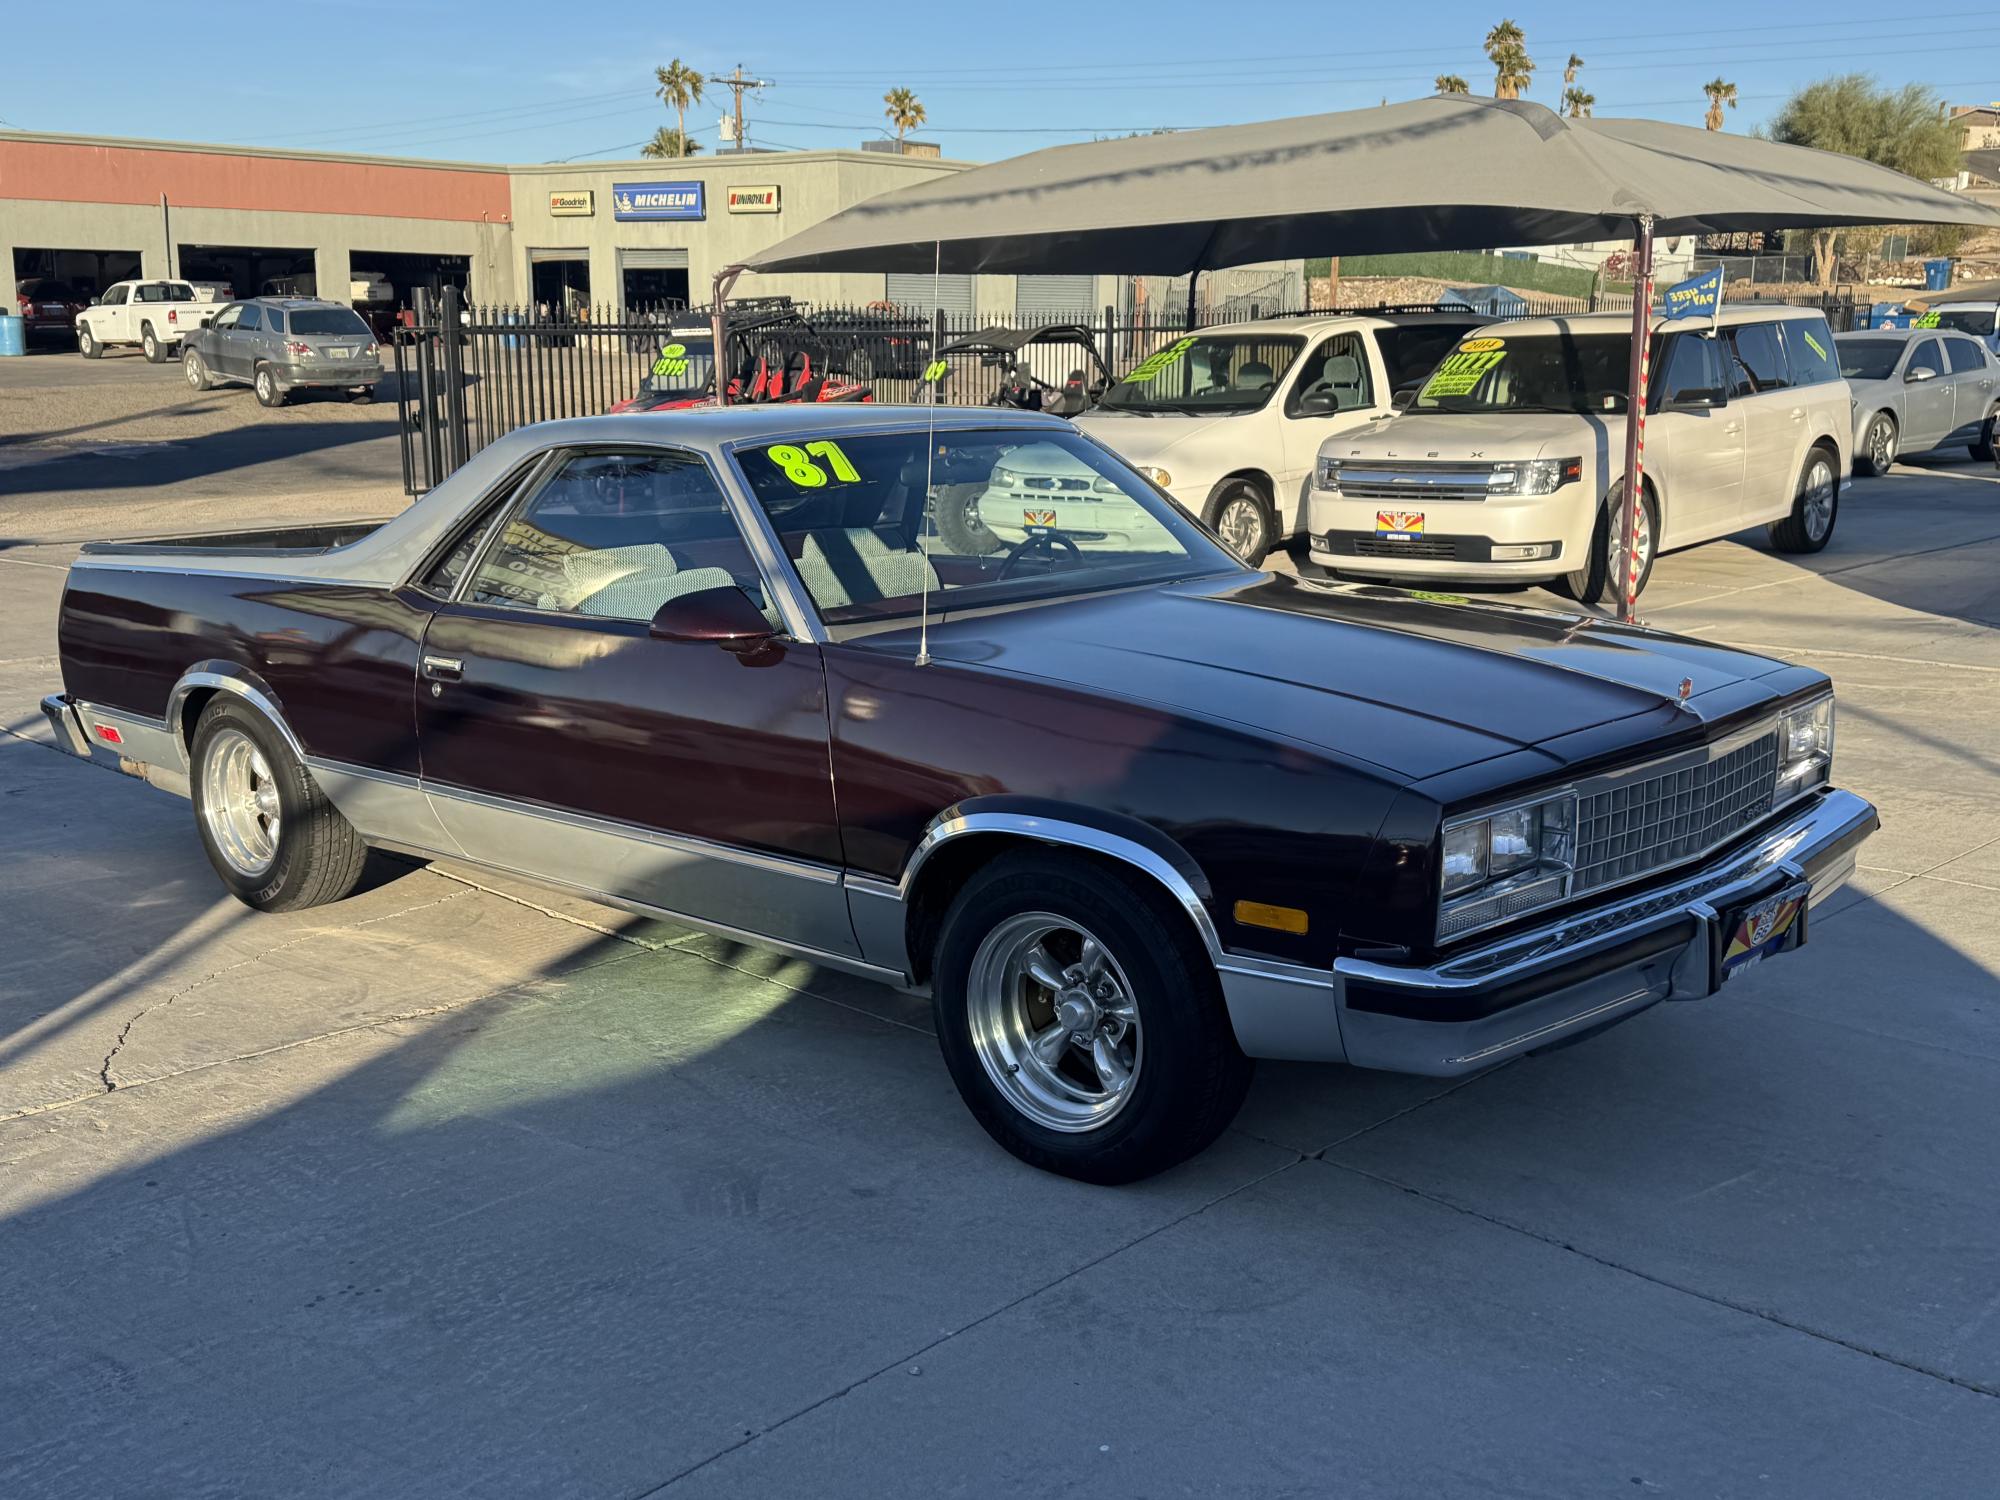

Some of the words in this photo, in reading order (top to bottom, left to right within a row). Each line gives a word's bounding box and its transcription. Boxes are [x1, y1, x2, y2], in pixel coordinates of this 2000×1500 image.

[551, 197, 587, 206] BFGoodrich
[634, 193, 697, 207] MICHELIN
[736, 193, 765, 205] UNIROYAL
[1350, 450, 1485, 458] FLEX
[767, 440, 862, 488] 87
